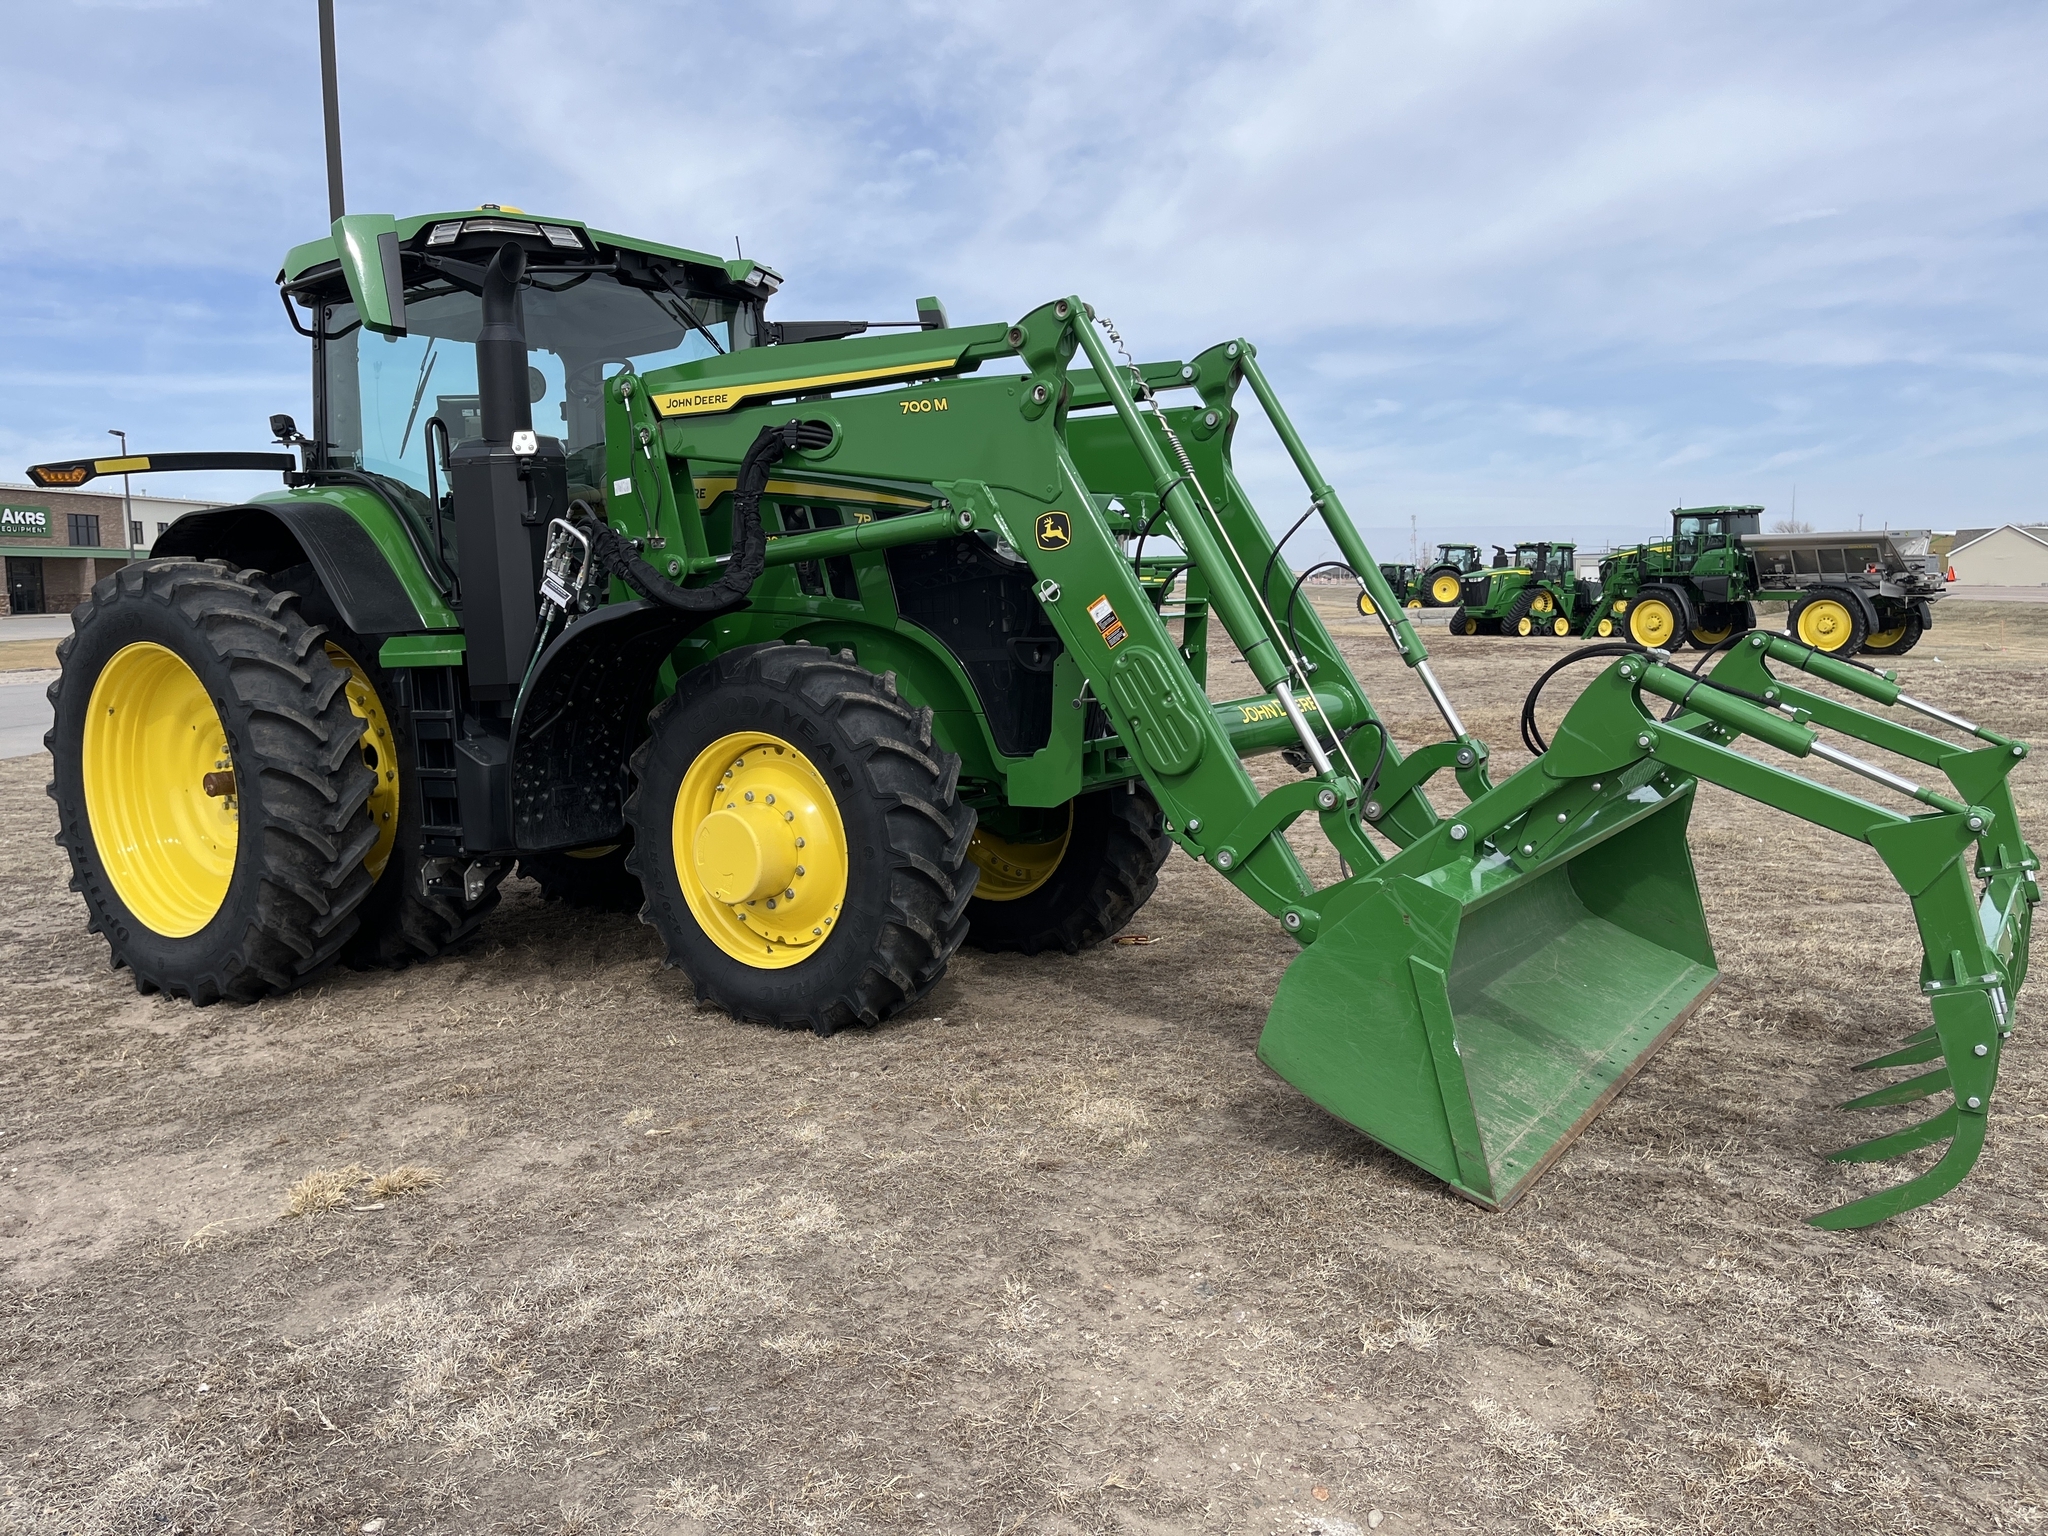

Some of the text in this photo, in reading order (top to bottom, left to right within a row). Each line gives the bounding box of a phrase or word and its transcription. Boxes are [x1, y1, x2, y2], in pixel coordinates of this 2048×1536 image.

[666, 394, 728, 409] JOHN DEERE
[899, 397, 948, 414] 700 M
[1, 508, 46, 525] AKRS
[1, 525, 46, 533] EQUIPMENT
[1238, 696, 1317, 724] JOHN DRE
[687, 695, 855, 792] GOODYEAR
[64, 799, 131, 943] OPTITRAC
